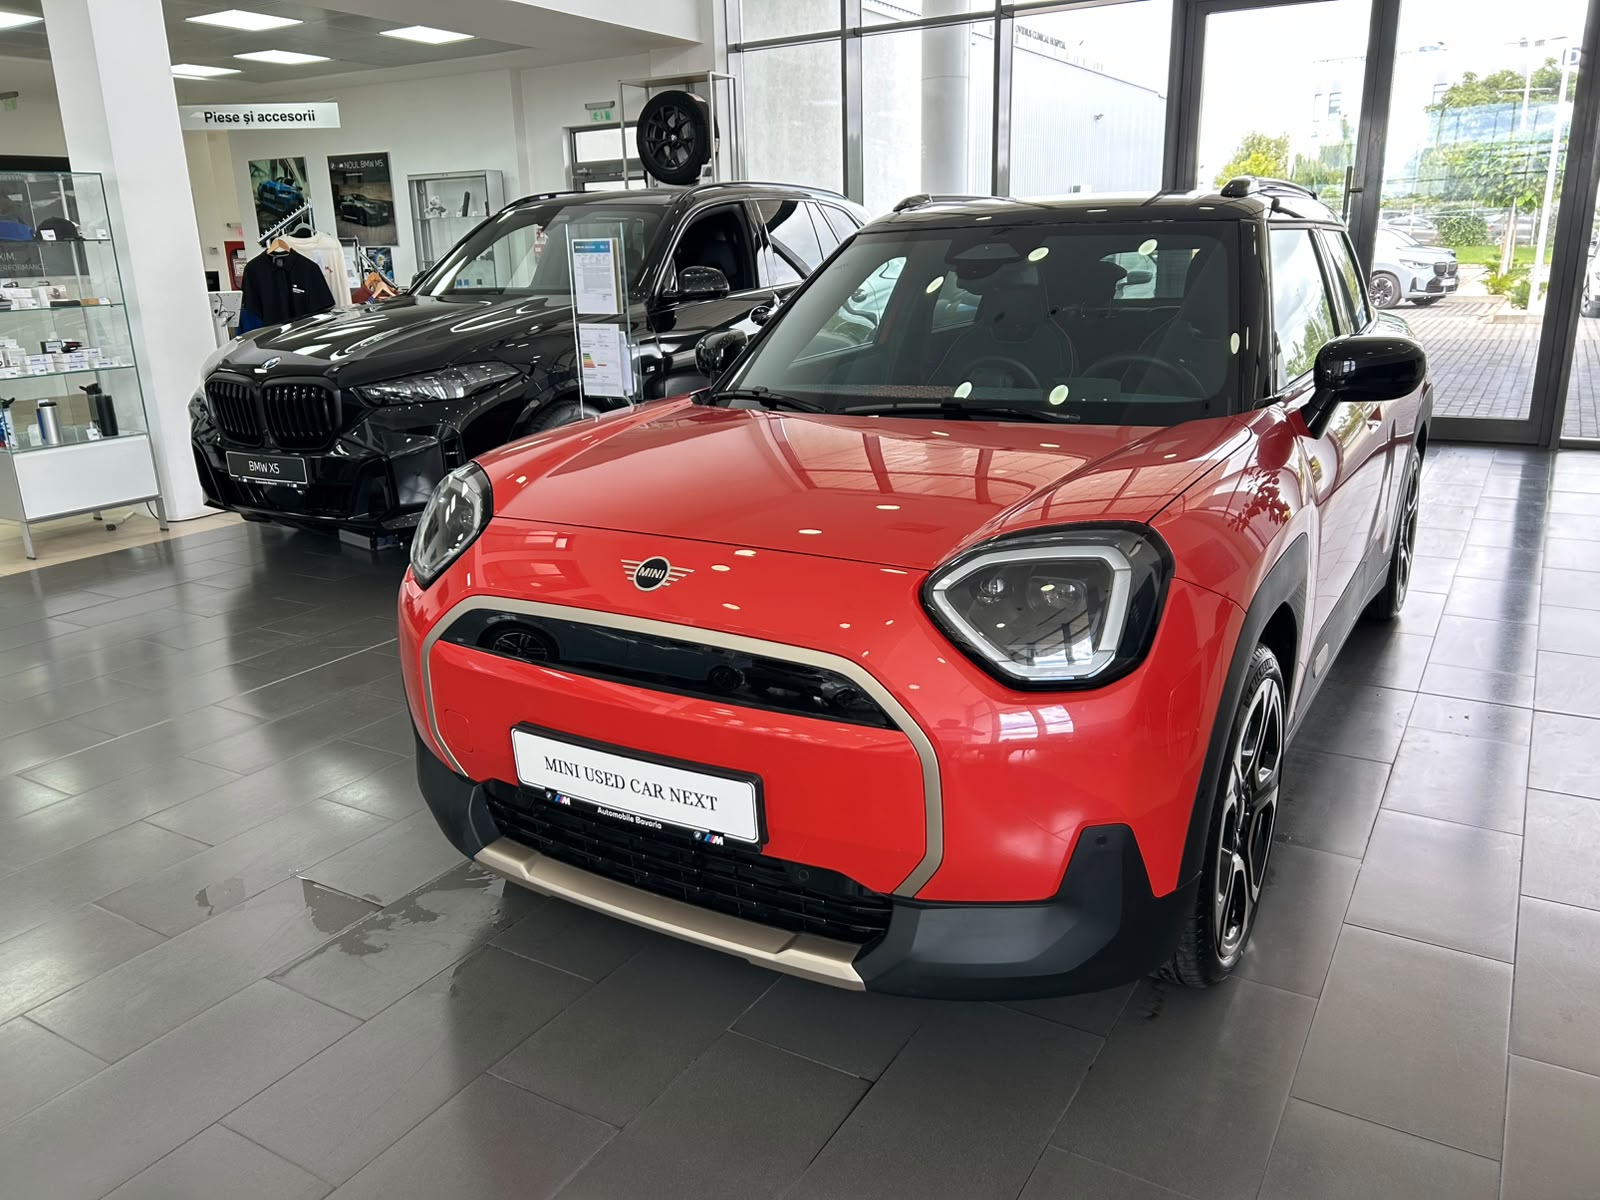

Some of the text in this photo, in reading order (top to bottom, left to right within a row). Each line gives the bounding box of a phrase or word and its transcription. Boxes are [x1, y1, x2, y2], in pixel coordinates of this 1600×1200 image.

[203, 109, 316, 125] Piese și accesorii
[248, 460, 280, 474] BMW X5
[638, 566, 665, 579] MINI
[544, 756, 718, 811] MINI USED CAR NEXT
[597, 807, 662, 829] Automobile Bavaria
